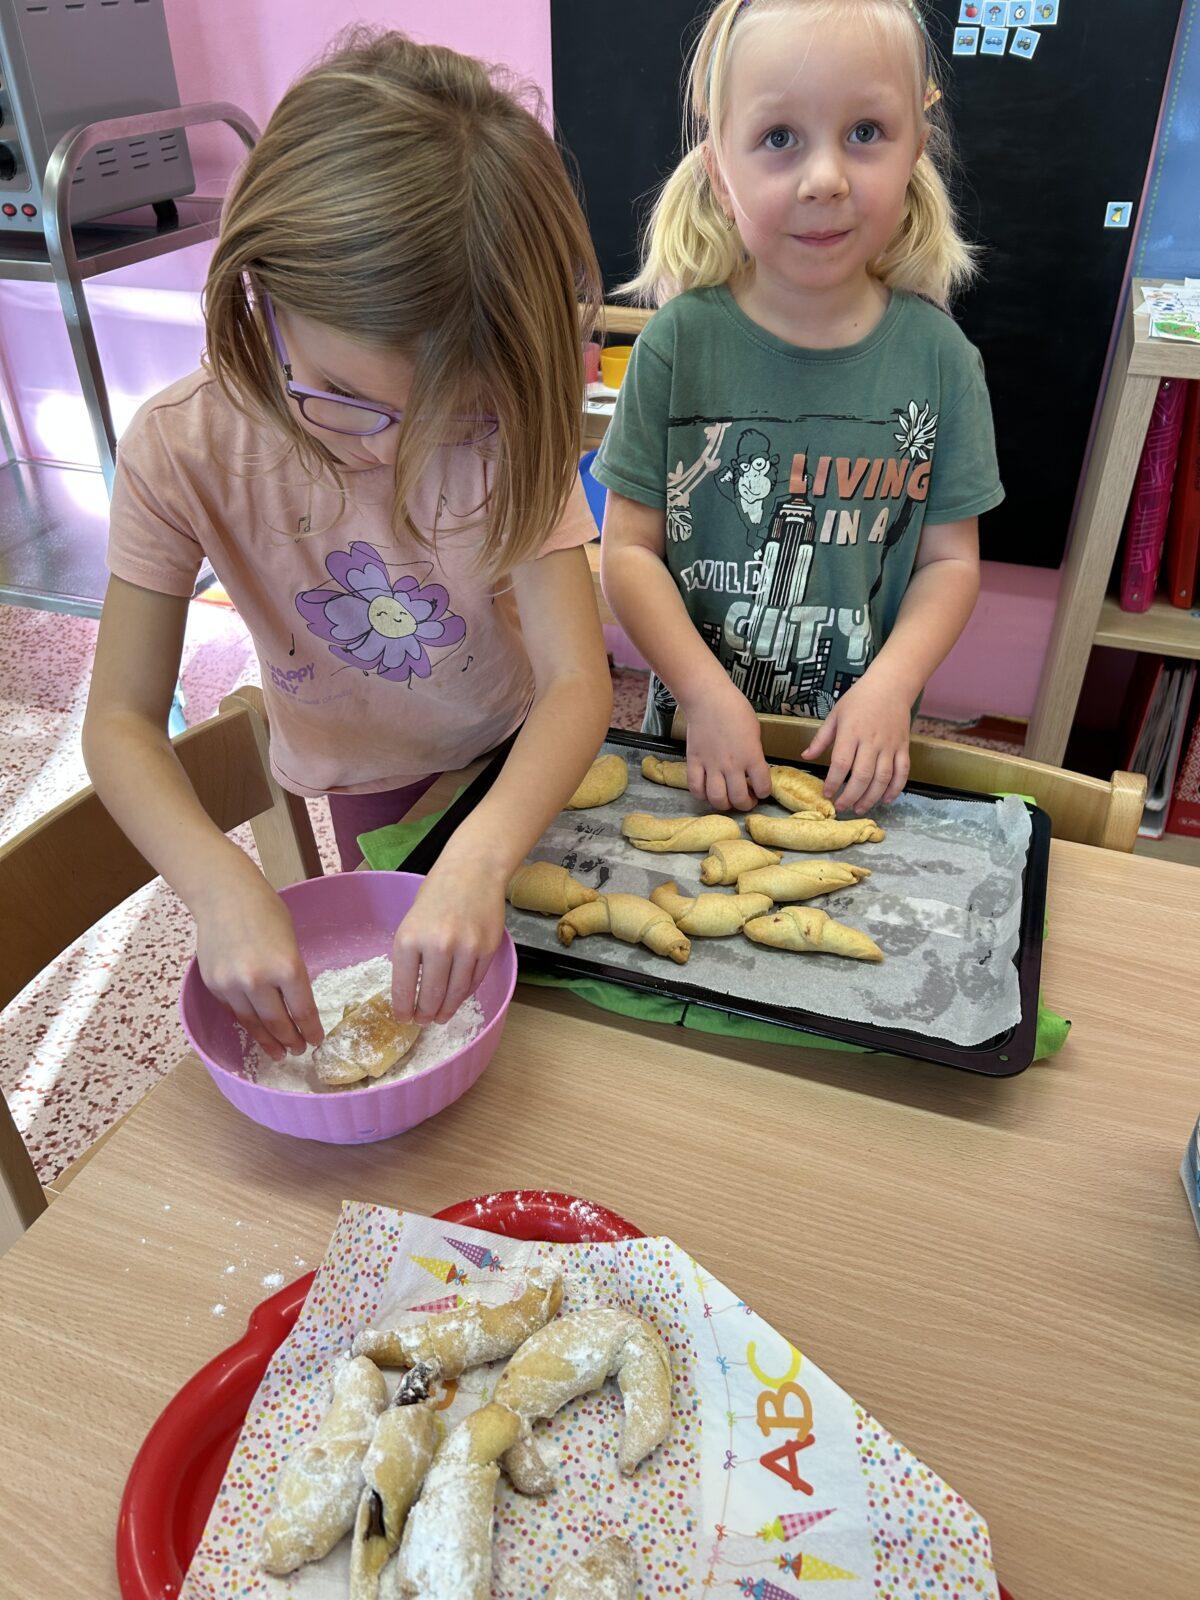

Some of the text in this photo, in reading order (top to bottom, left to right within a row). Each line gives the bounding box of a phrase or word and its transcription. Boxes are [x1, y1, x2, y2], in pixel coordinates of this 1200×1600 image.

[788, 453, 931, 501] LIVING
[819, 507, 890, 545] IN A
[680, 559, 769, 595] WILD
[723, 601, 872, 666] CITY
[746, 1340, 816, 1496] ABC
